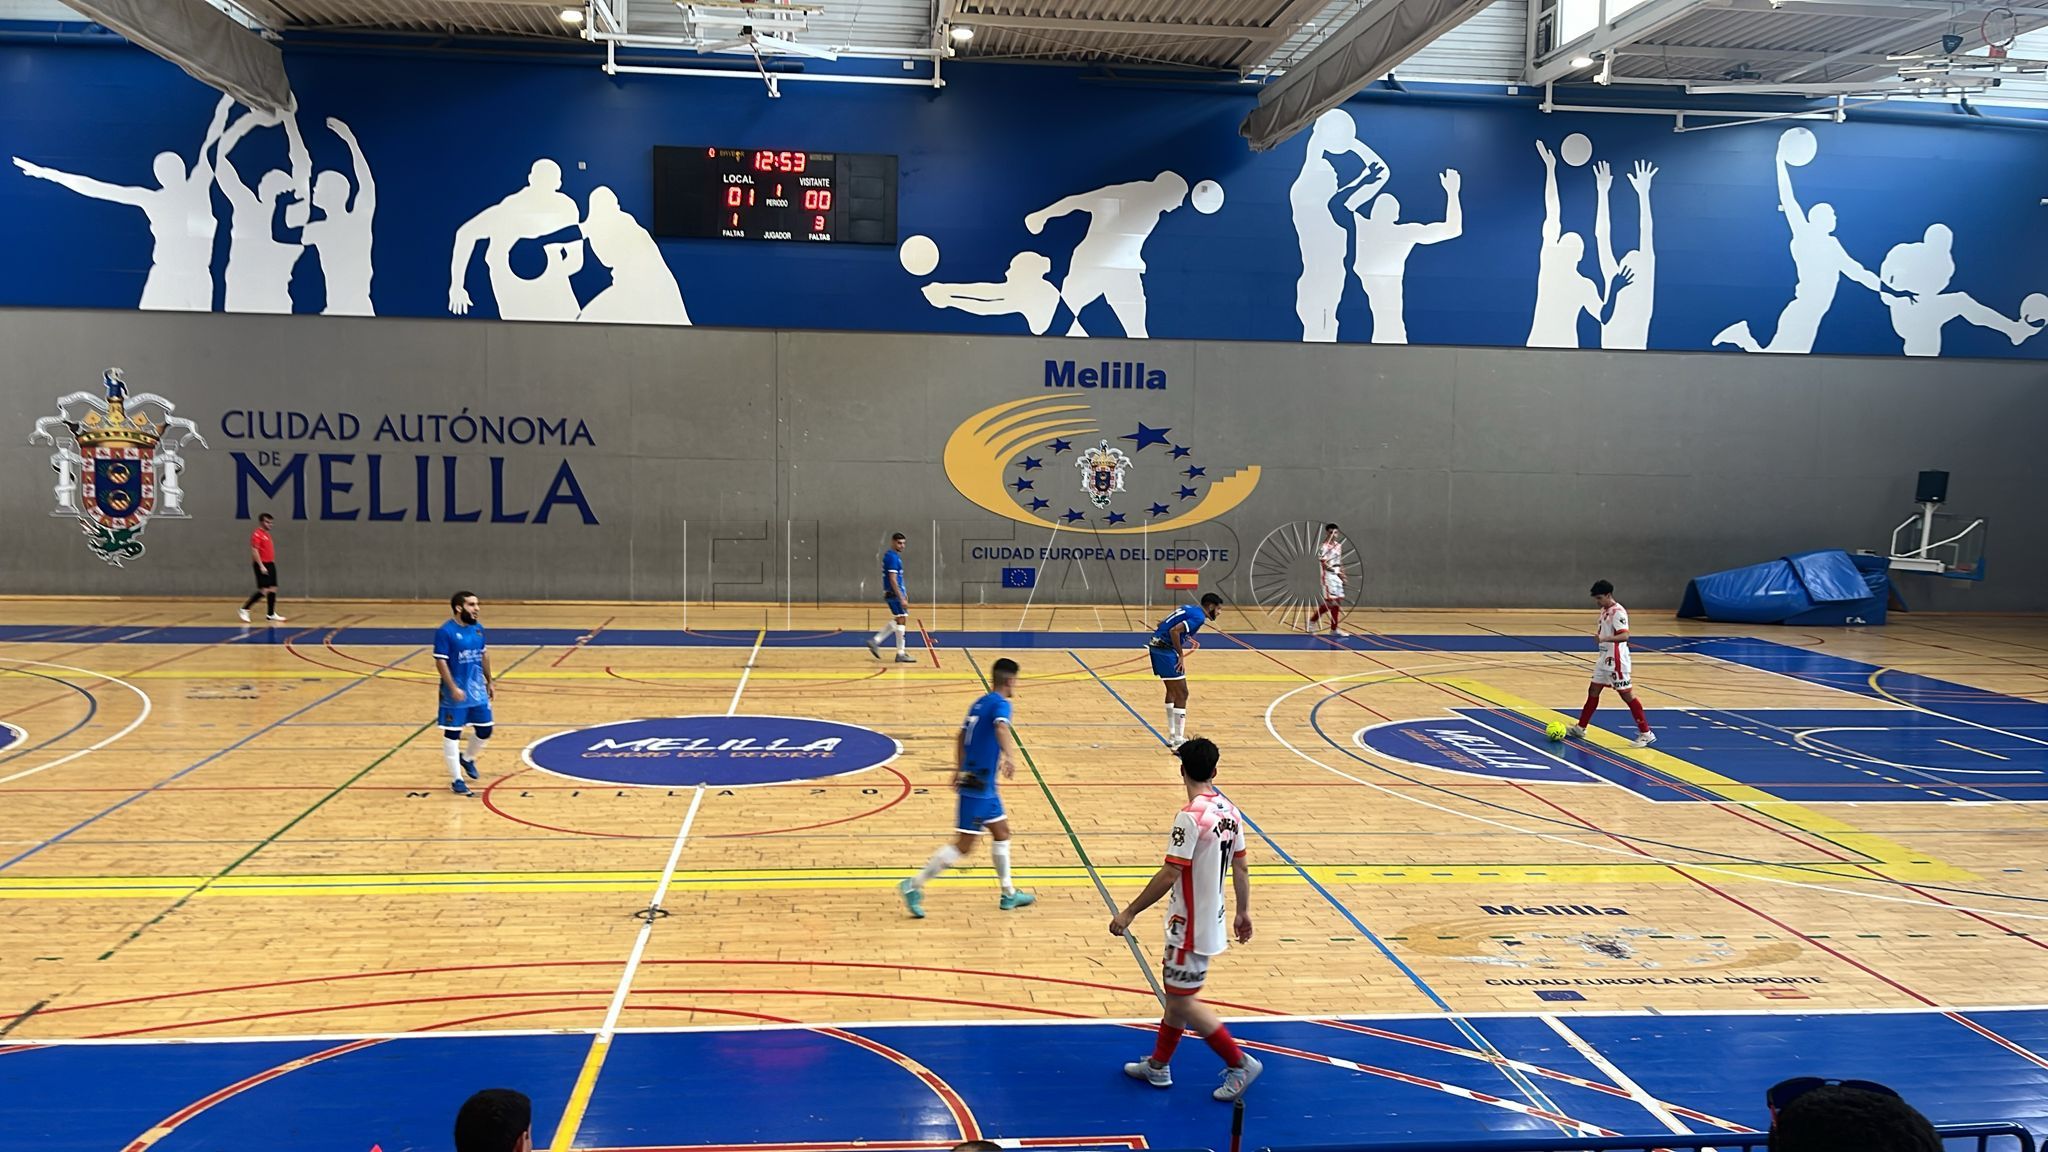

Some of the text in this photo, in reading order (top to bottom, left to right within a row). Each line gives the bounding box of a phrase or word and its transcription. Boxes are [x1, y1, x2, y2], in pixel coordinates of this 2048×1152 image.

[755, 150, 805, 172] 12:53
[723, 174, 754, 184] LOCAL
[799, 177, 830, 187] VISITANTE
[728, 186, 755, 206] 01
[775, 183, 782, 197] 1
[766, 199, 789, 207] PERIODO
[805, 190, 831, 210] 00
[732, 212, 739, 227] 1
[815, 215, 825, 231] 3
[722, 229, 745, 237] FALTAS
[763, 231, 792, 240] JUGADOR
[808, 233, 831, 241] FALTAS
[1044, 359, 1167, 390] Melilla
[221, 407, 596, 446] CIUDAD AUTÓNOMA
[258, 450, 282, 467] DE
[229, 452, 600, 525] MELILLA
[971, 546, 1229, 562] CIUDAD EUROPEA DEL DEPORTE
[587, 737, 843, 751] MELILLA
[406, 790, 736, 798] MLILLA
[1478, 904, 1631, 916] Melilla
[1485, 977, 1571, 987] CIUDAD
[1724, 975, 1829, 985] DEPORTE
